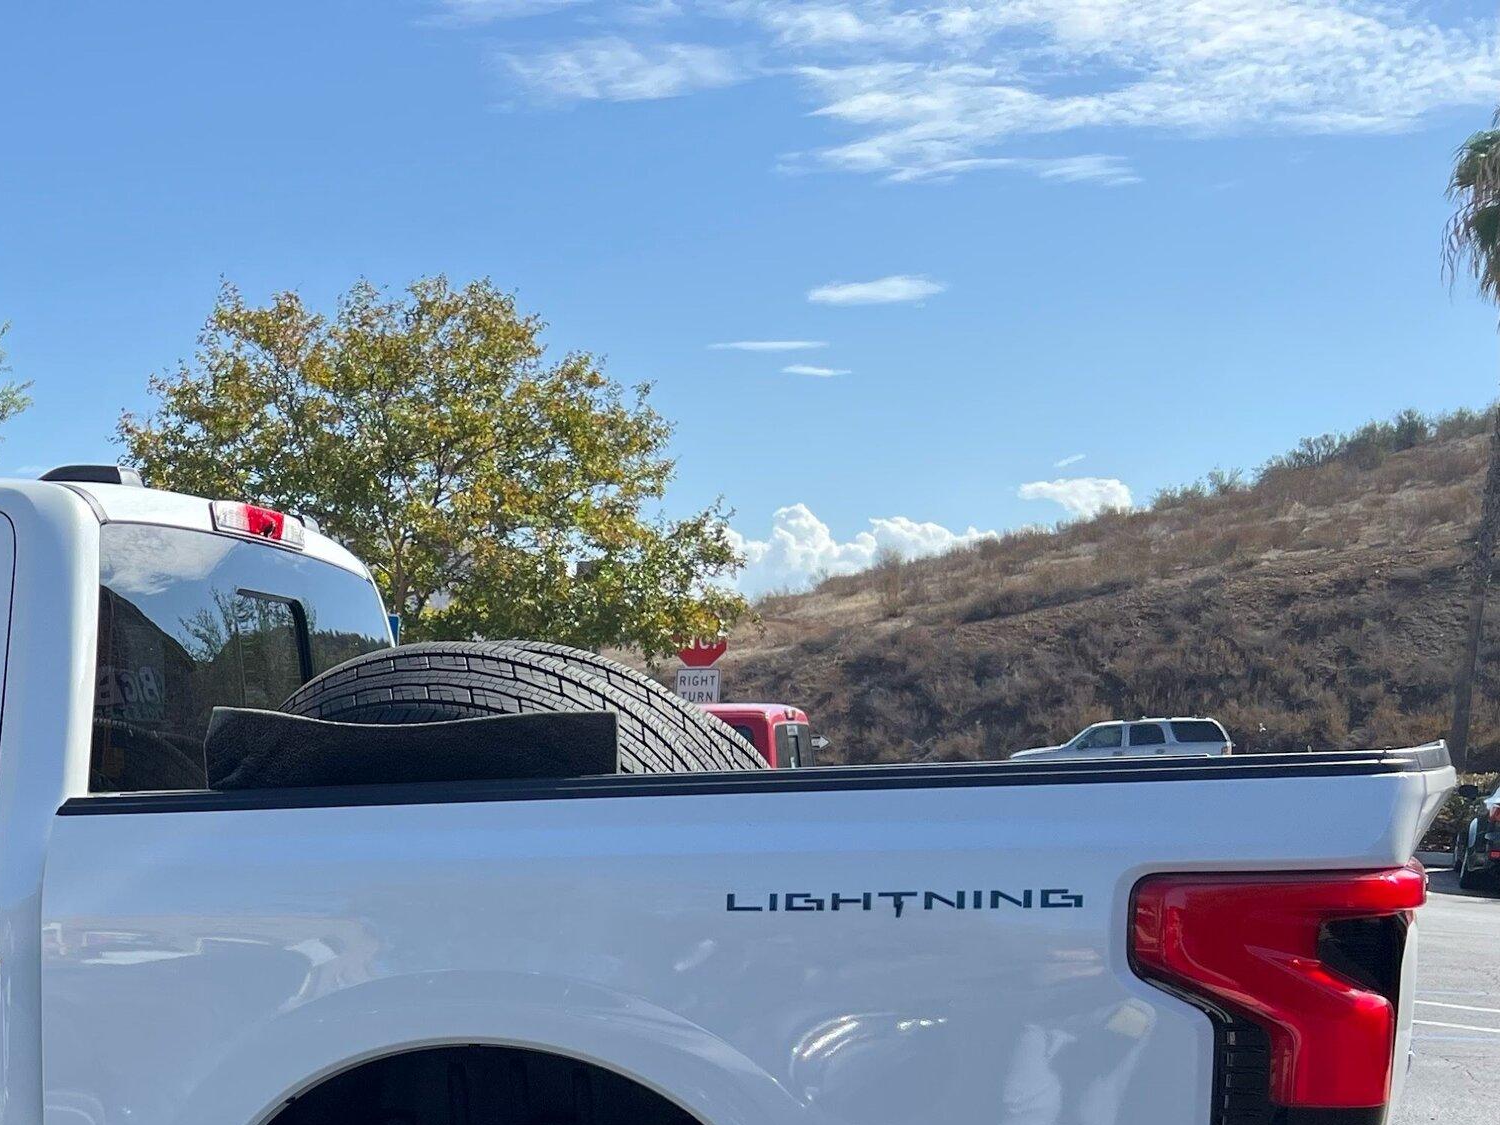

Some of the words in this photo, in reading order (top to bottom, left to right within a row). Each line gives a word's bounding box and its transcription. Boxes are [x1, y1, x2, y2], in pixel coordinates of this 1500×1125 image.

[680, 676, 715, 686] RIGHT
[681, 691, 714, 703] TURN
[726, 889, 1084, 918] LIGHTNING
